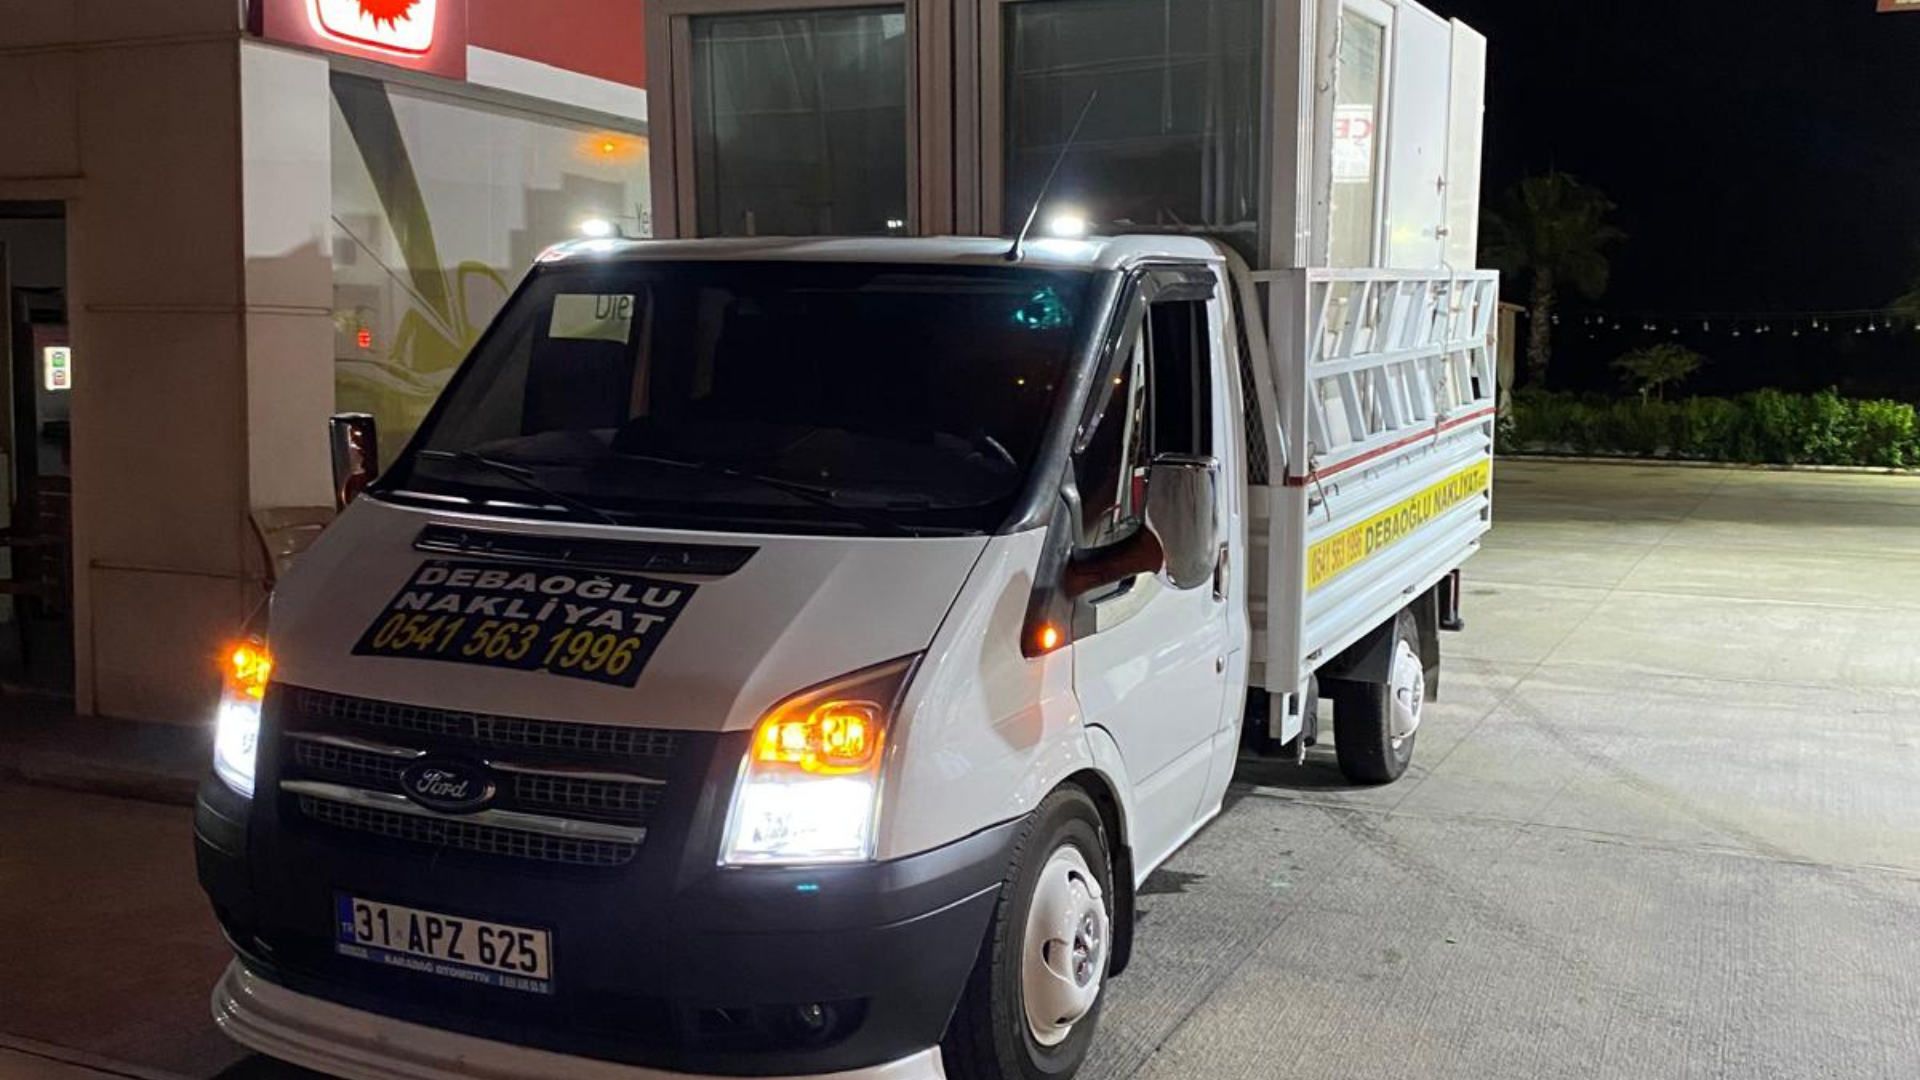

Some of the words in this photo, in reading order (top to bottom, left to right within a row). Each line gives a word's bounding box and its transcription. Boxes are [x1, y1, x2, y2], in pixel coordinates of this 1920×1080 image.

[1365, 495, 1431, 555] DEBAOĞLU
[1433, 470, 1479, 512] NAKLİYAT
[395, 590, 667, 635] NAKLİYAT
[415, 566, 681, 609] DEBAOĞLU
[372, 613, 462, 651] 0541
[462, 619, 540, 661] 563
[541, 627, 641, 676] 1996
[416, 769, 469, 798] Ford
[356, 904, 391, 946] 31
[408, 913, 465, 960] APZ
[477, 925, 538, 973] 625
